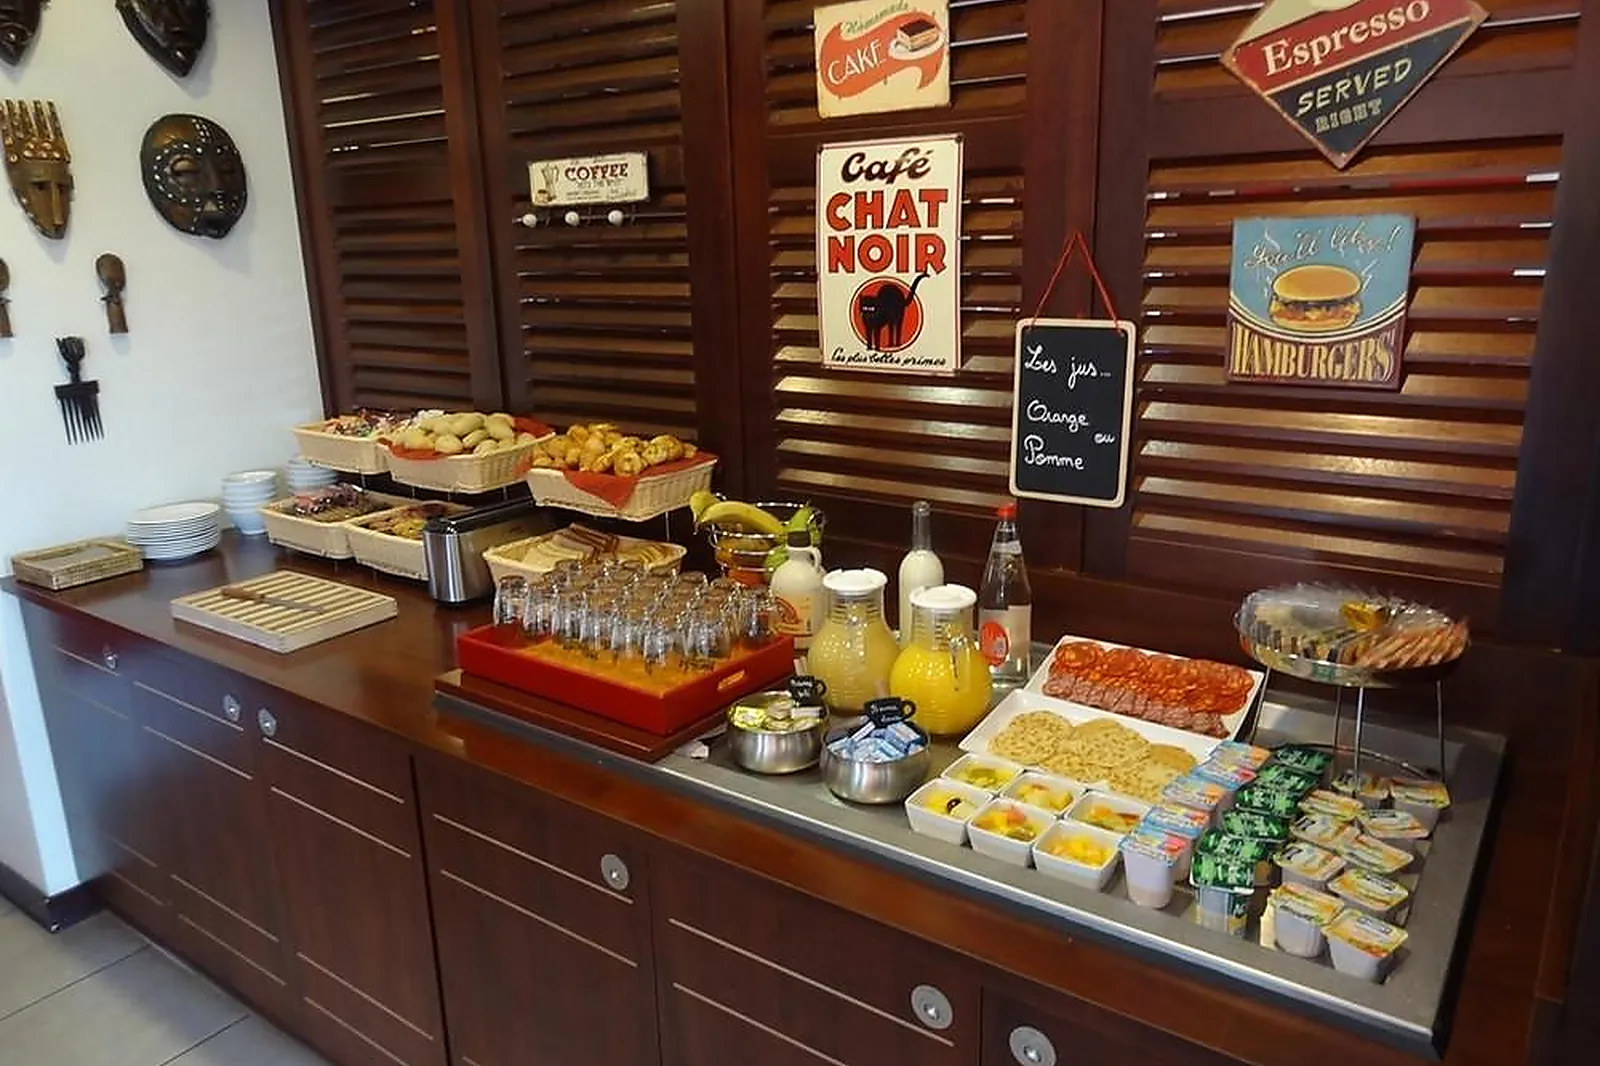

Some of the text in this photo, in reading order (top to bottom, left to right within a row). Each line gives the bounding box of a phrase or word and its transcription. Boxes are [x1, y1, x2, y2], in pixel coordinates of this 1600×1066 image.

[1262, 0, 1431, 76] Espresso
[828, 39, 886, 85] CAKE
[1296, 57, 1413, 118] SERVED
[564, 163, 629, 181] COFFEE
[841, 147, 933, 185] Café
[826, 188, 949, 231] CHAT
[827, 233, 947, 274] NOIR
[901, 355, 947, 367] primes
[1024, 344, 1057, 374] Les
[1228, 321, 1396, 382] HAMBURGERS
[1026, 400, 1089, 433] Orange
[1024, 434, 1085, 471] Pomme
[1094, 433, 1116, 444] ou
